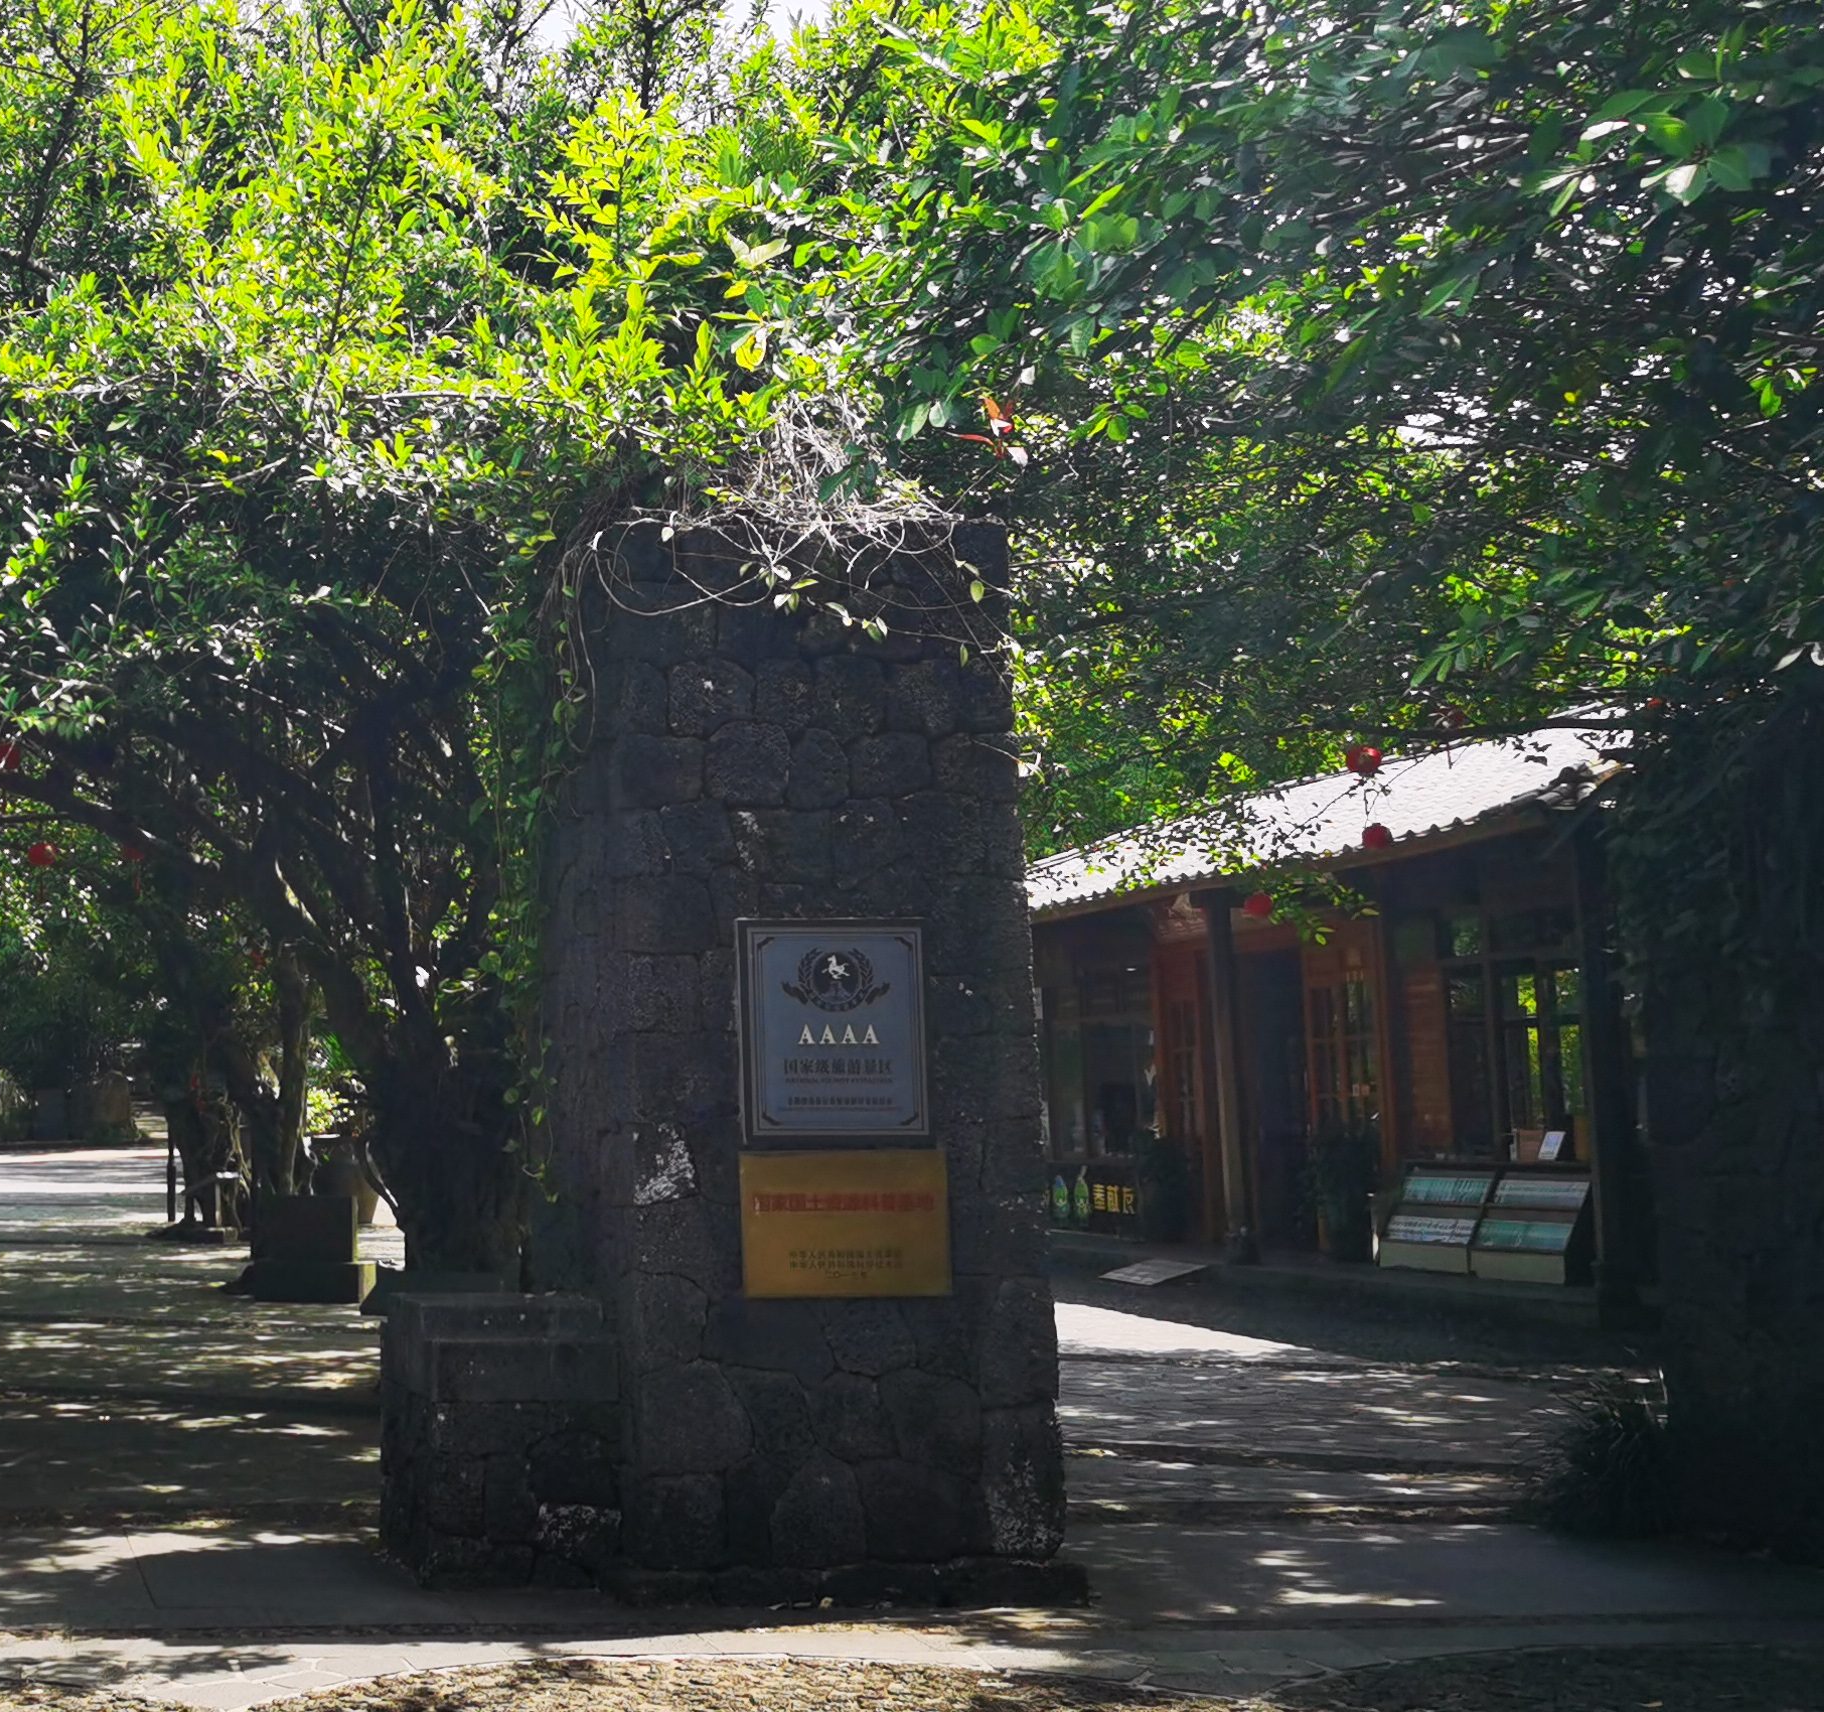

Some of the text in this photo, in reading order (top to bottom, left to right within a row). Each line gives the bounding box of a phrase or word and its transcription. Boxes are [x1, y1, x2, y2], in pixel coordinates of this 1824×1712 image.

[798, 1023, 881, 1045] AAAA
[784, 1057, 895, 1076] 国家级旅游景区
